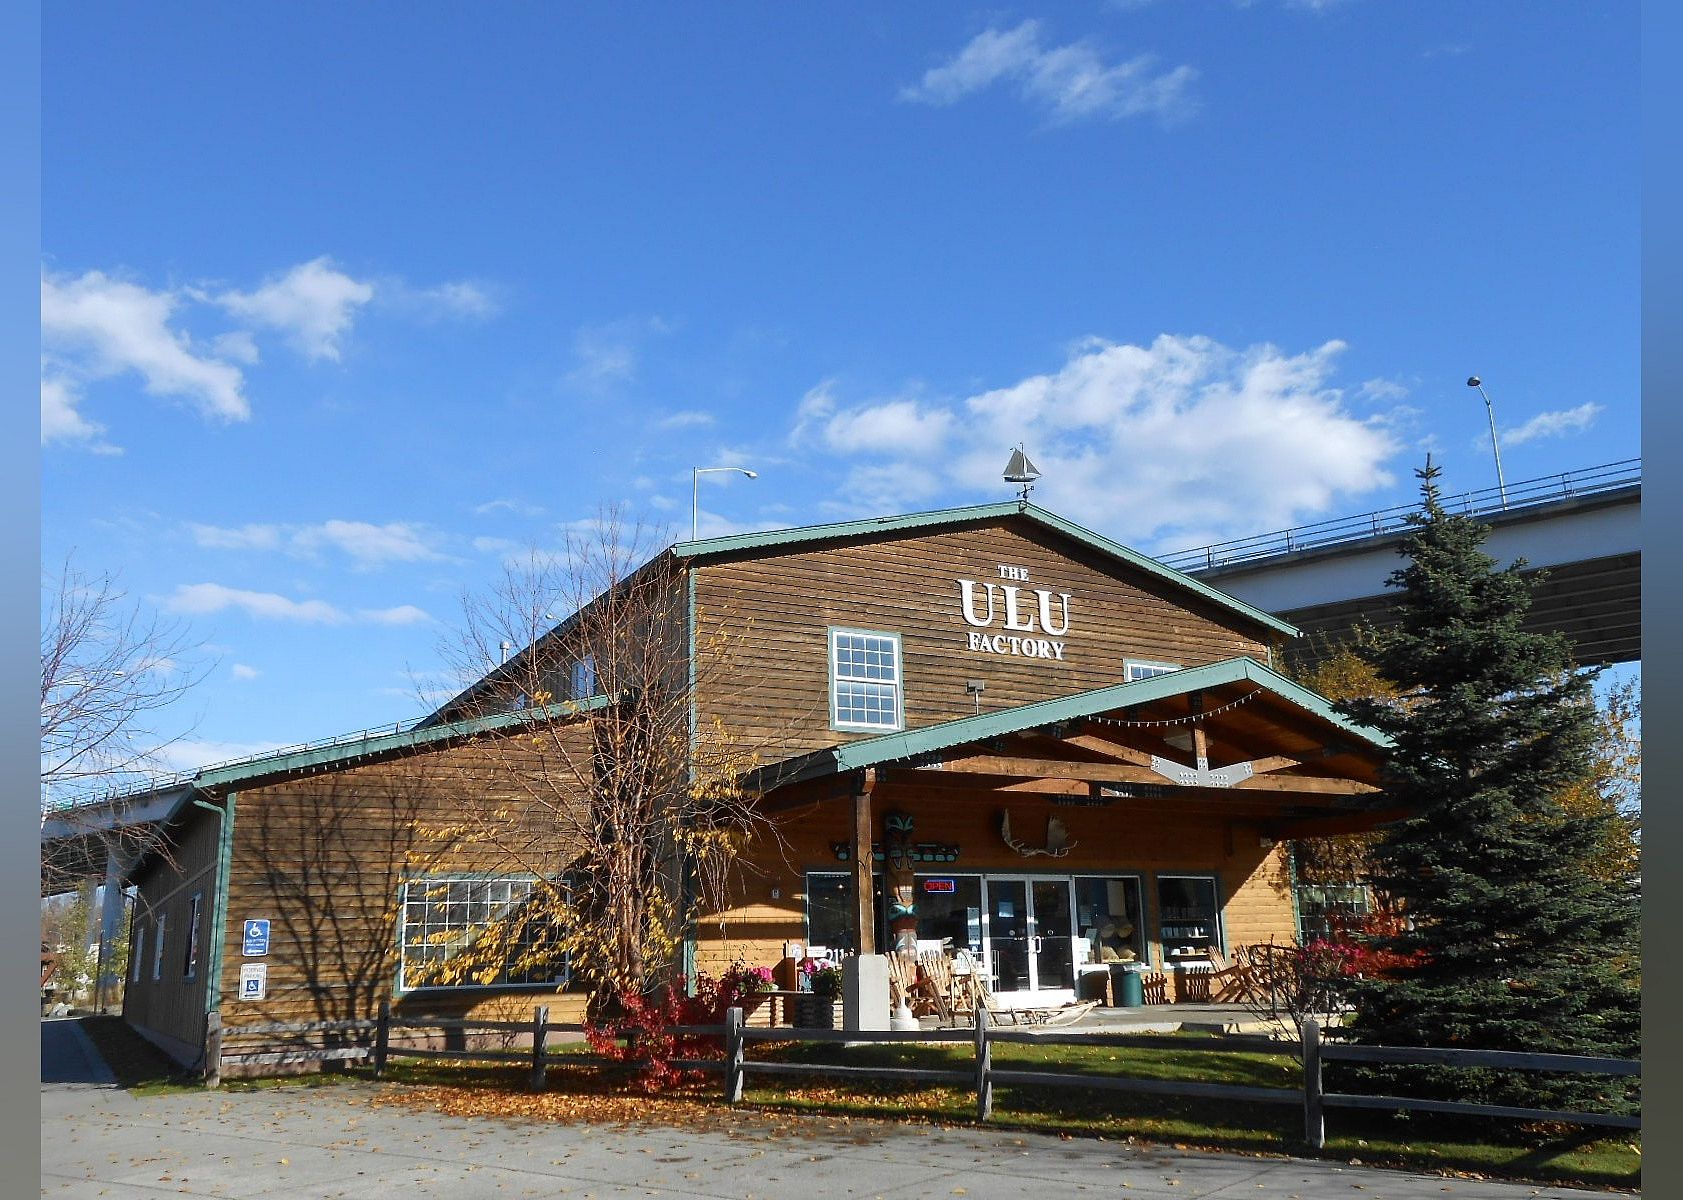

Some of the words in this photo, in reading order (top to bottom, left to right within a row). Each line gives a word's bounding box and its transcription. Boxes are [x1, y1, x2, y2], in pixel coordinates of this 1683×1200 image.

[998, 565, 1029, 581] THE
[956, 579, 1071, 636] ULU
[966, 631, 1064, 660] FACTORY
[925, 881, 952, 891] OPEN
